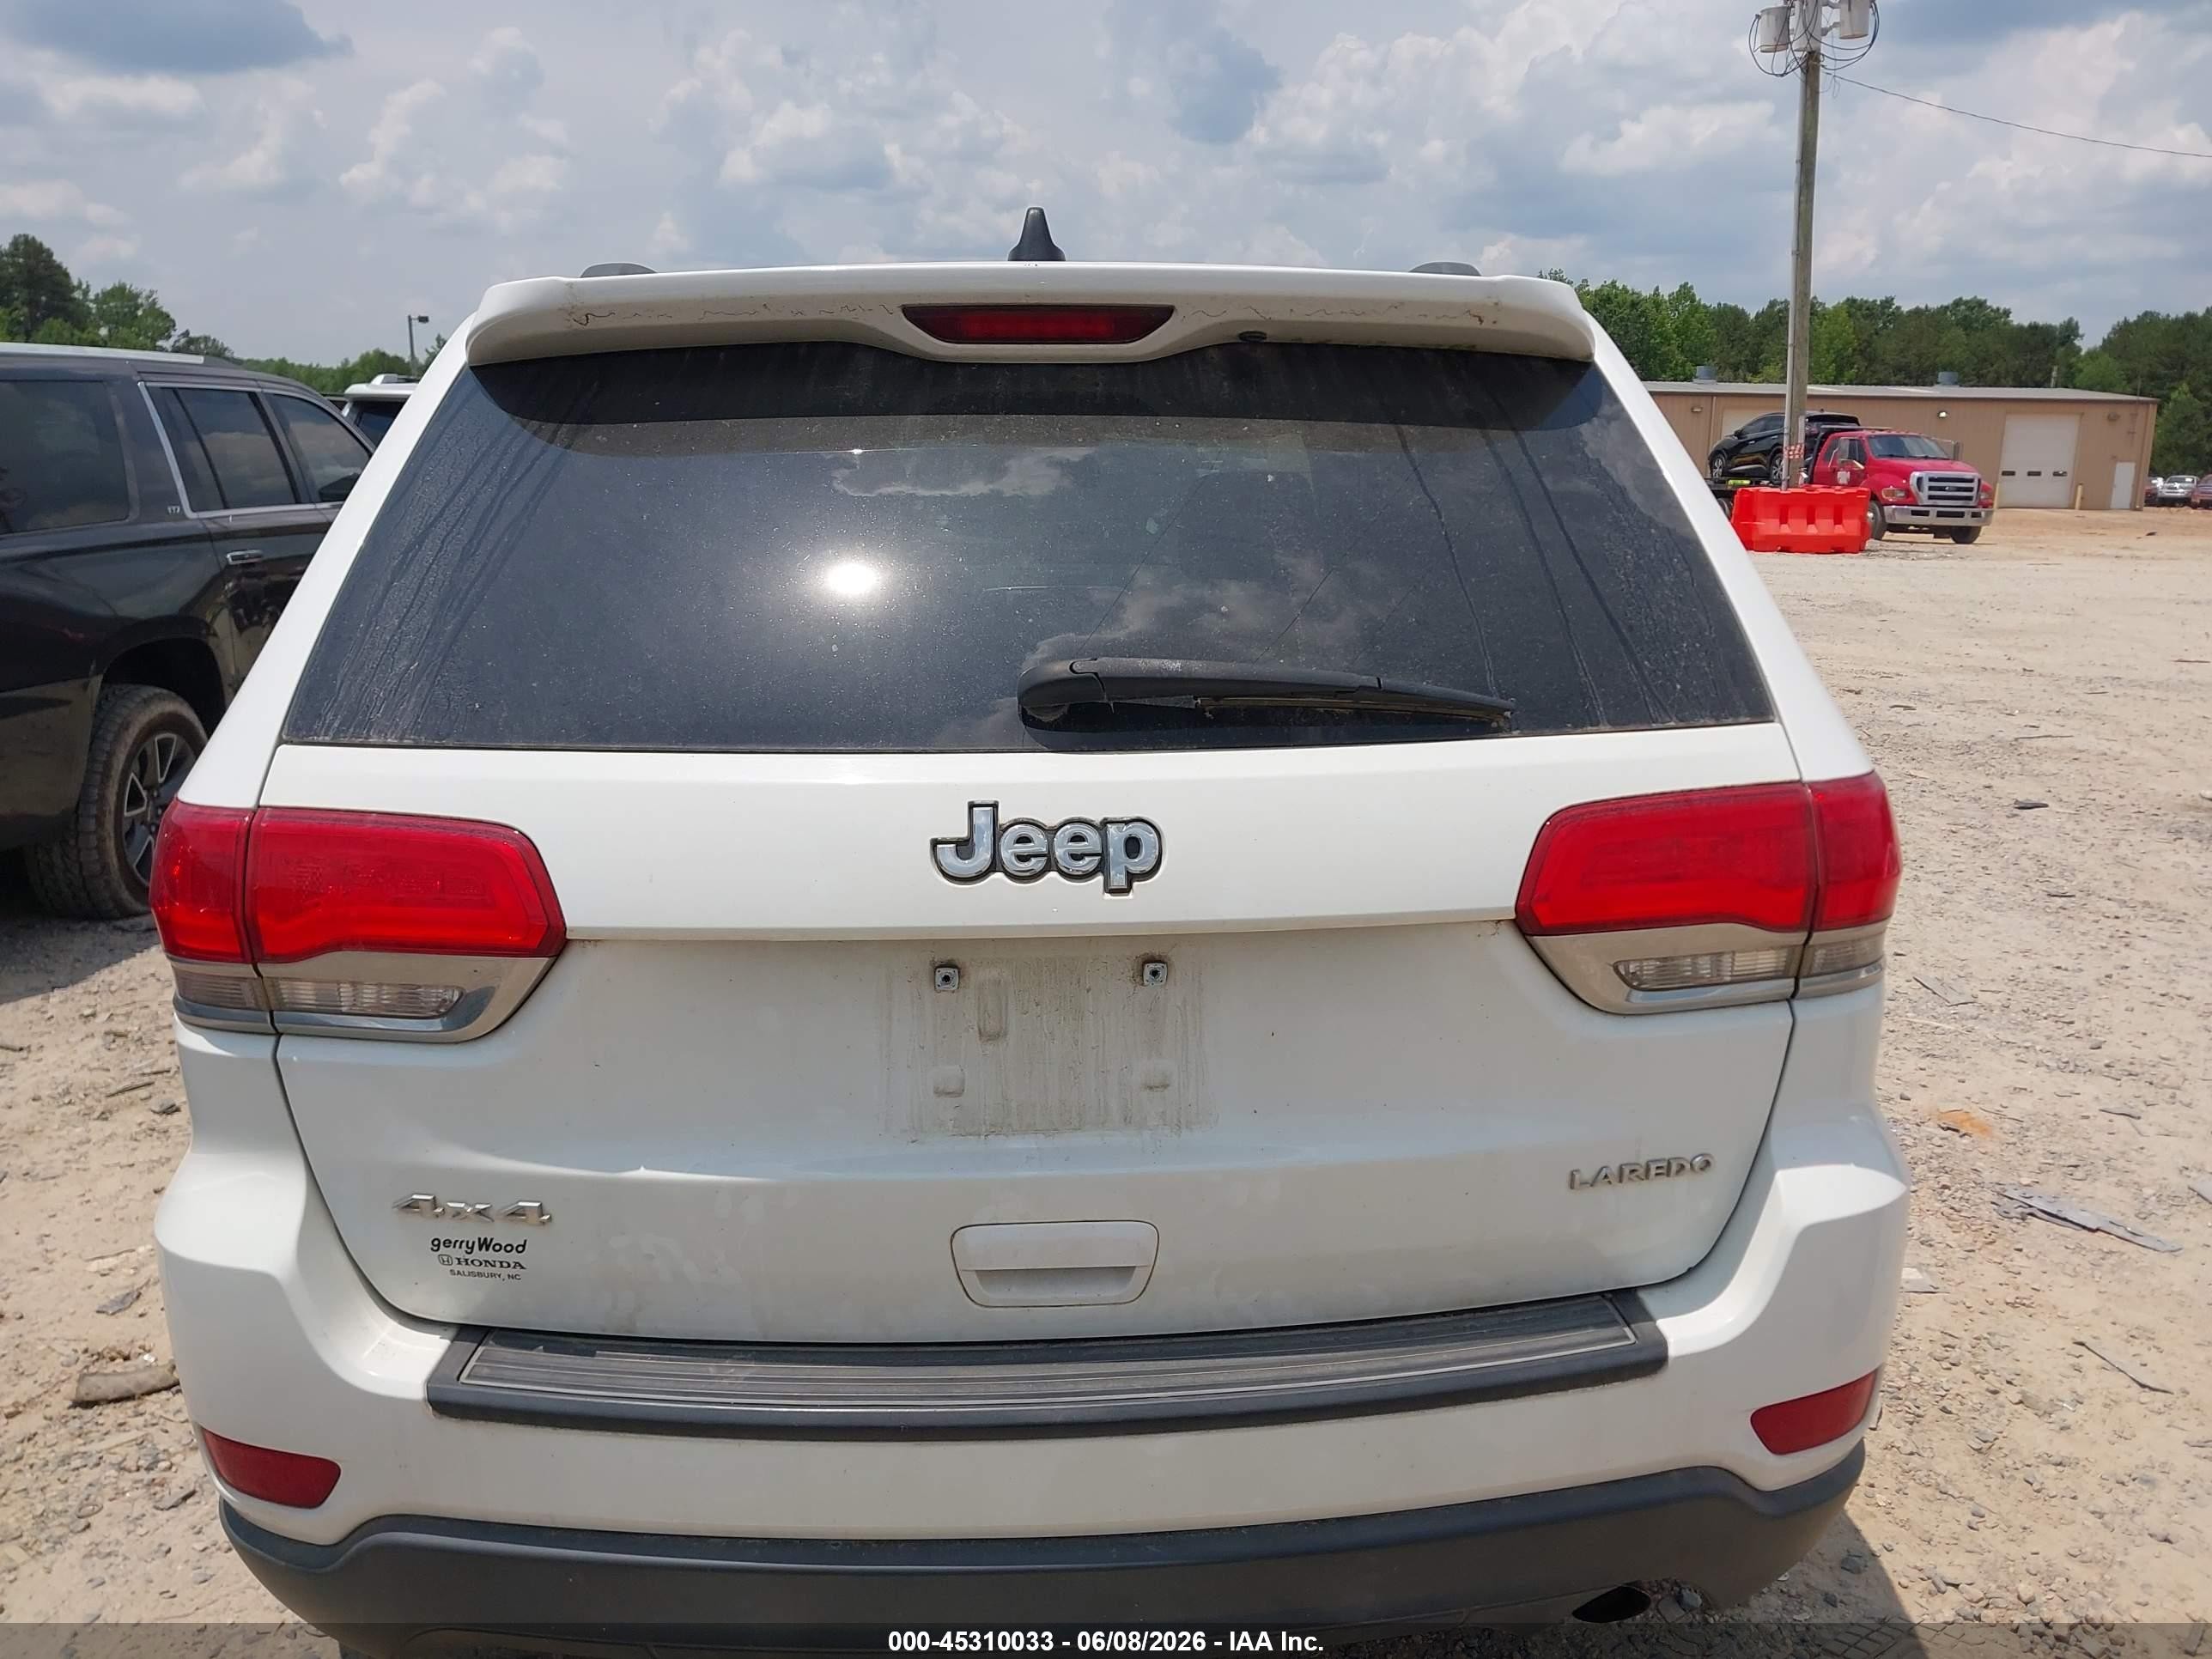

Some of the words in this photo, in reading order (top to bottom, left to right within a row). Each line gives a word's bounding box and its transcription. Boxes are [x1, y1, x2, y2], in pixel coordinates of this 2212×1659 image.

[930, 800, 1163, 895] Jeep
[1570, 1152, 1714, 1190] LAREDO
[450, 1269, 505, 1281] SALISBURY,
[456, 1256, 526, 1270] HONDA
